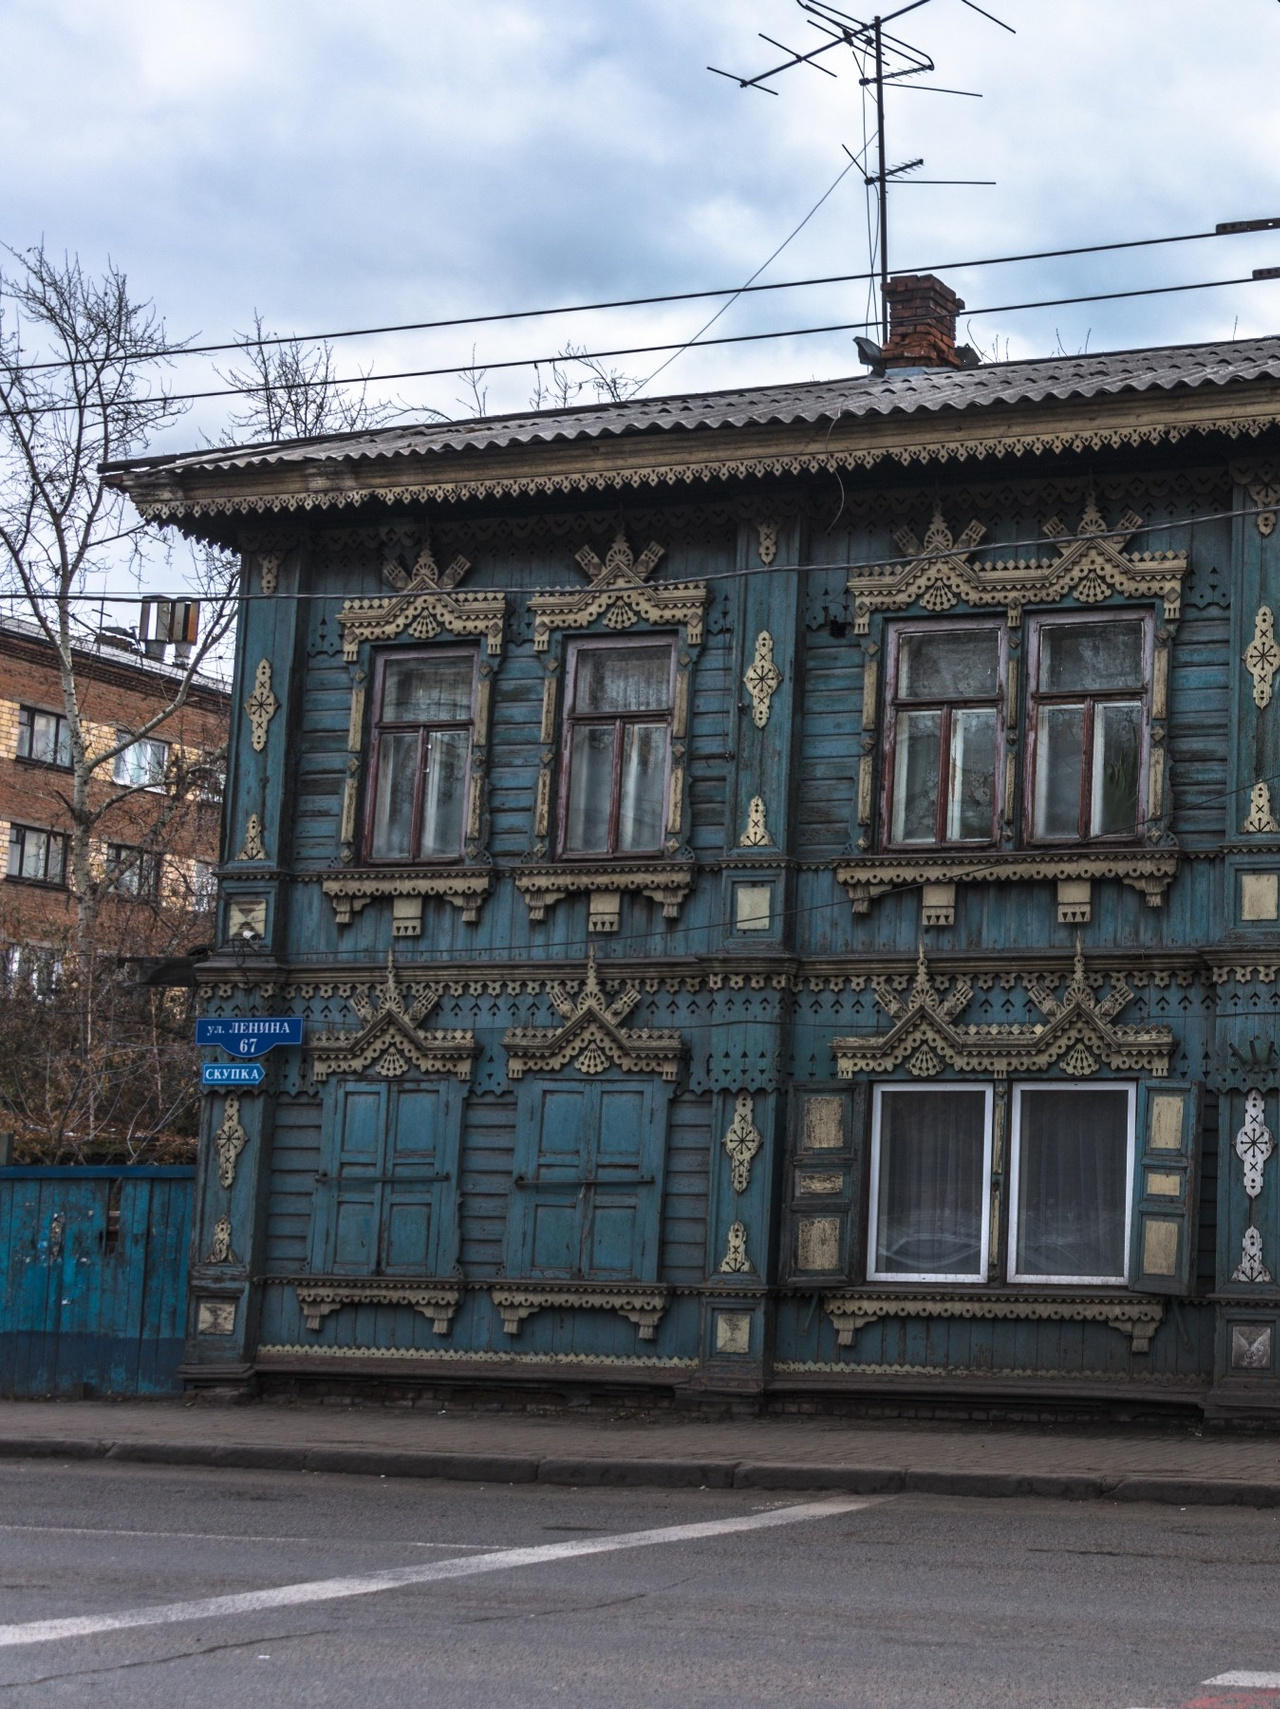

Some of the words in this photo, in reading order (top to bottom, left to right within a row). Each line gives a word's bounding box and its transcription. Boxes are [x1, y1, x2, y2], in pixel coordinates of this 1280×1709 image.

[206, 1024, 225, 1036] ул.
[229, 1021, 290, 1034] ЛЕНИНА
[239, 1038, 258, 1053] 67
[205, 1068, 260, 1080] СКУПКА
